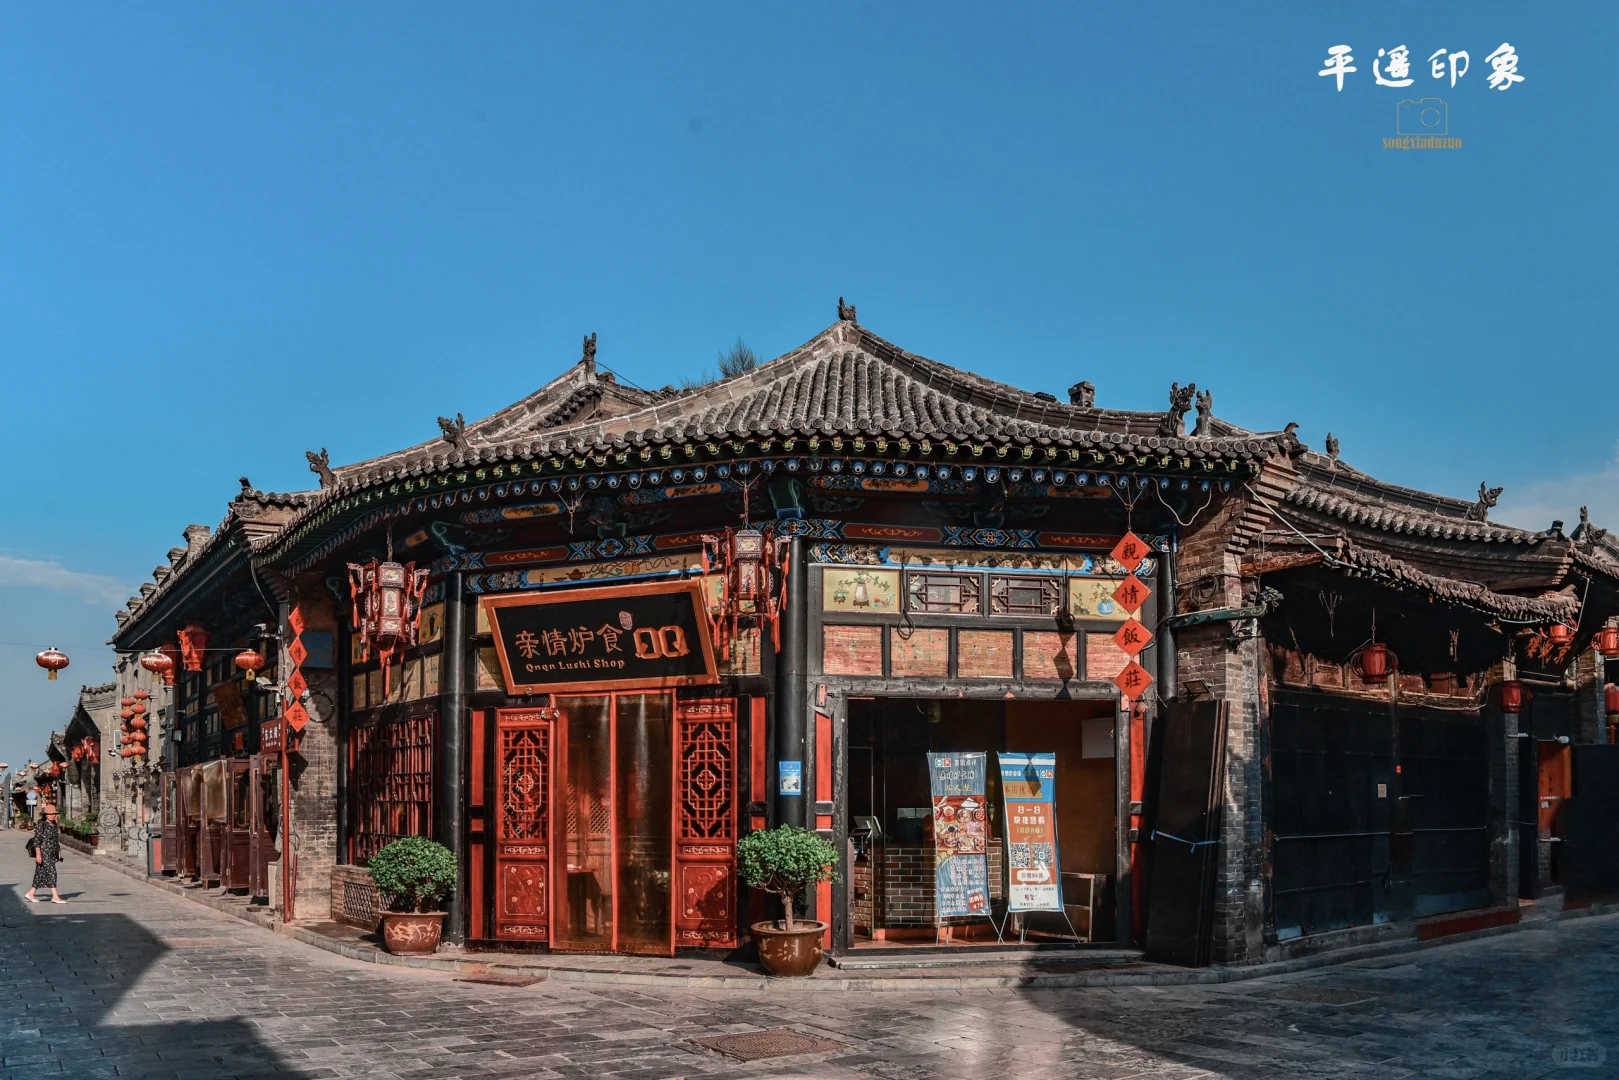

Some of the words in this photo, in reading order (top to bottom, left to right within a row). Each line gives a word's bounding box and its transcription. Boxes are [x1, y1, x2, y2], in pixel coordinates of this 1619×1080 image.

[1121, 542, 1142, 688] 親情飯莊
[515, 623, 623, 659] 亲情炉食
[558, 660, 591, 670] Lushi
[593, 658, 625, 670] Shop
